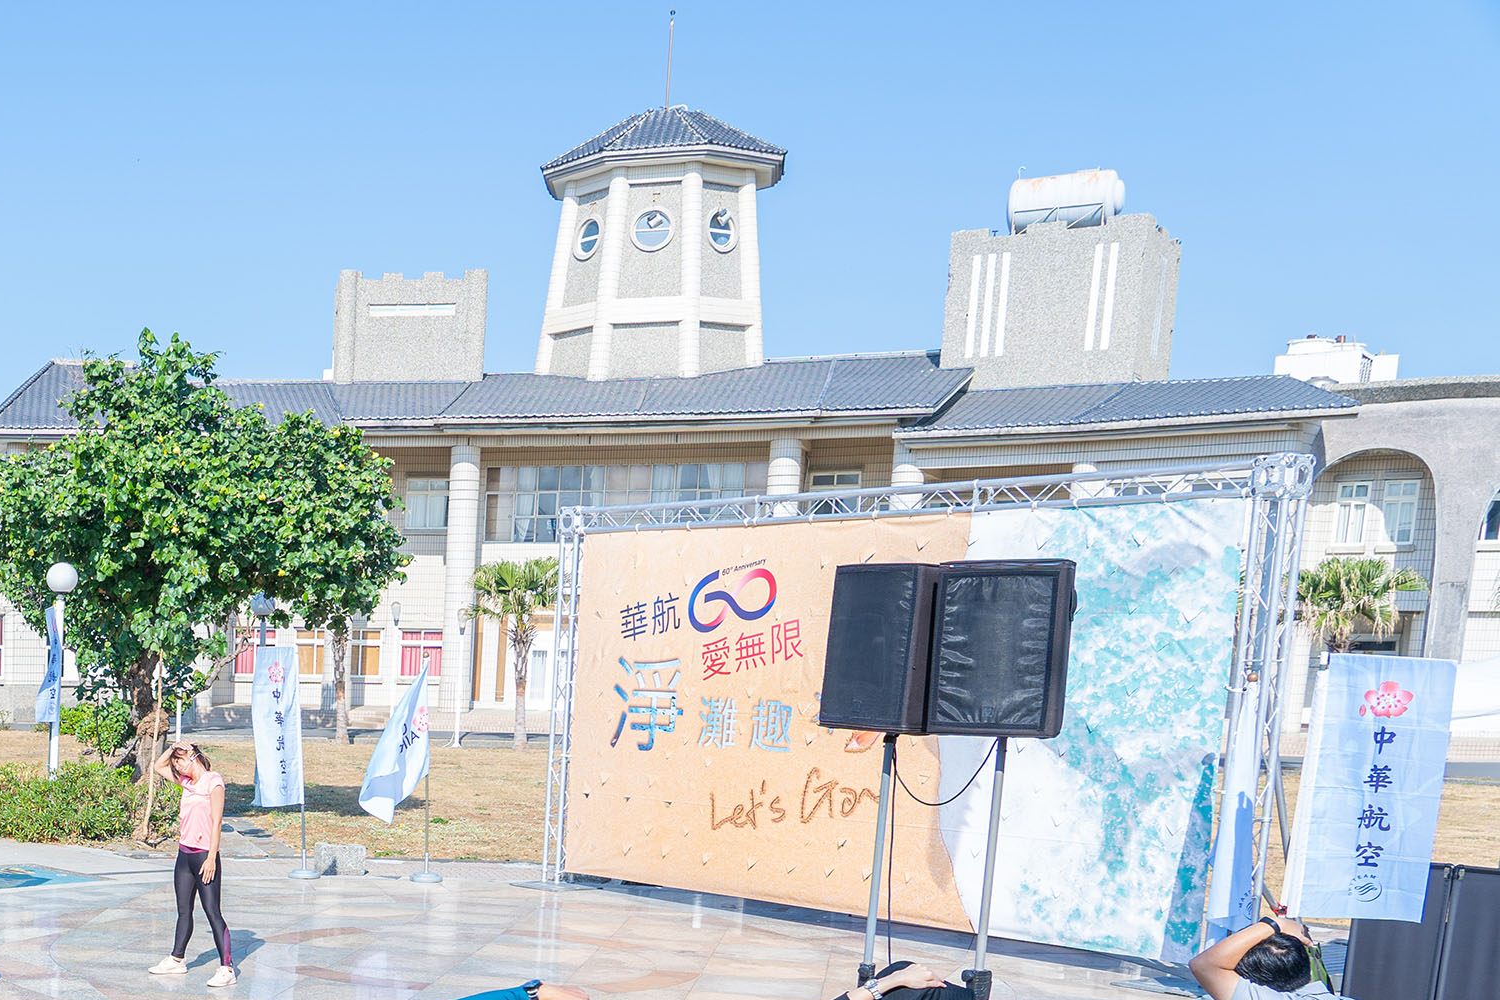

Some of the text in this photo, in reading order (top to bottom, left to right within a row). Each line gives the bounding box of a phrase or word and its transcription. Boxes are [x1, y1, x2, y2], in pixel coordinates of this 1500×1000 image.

[733, 558, 767, 573] Anniversary
[620, 592, 681, 641] 華航
[701, 618, 804, 681] 愛無限
[610, 656, 832, 753] 淨灘趣
[709, 779, 787, 830] Let's
[1354, 726, 1397, 868] 中華航空
